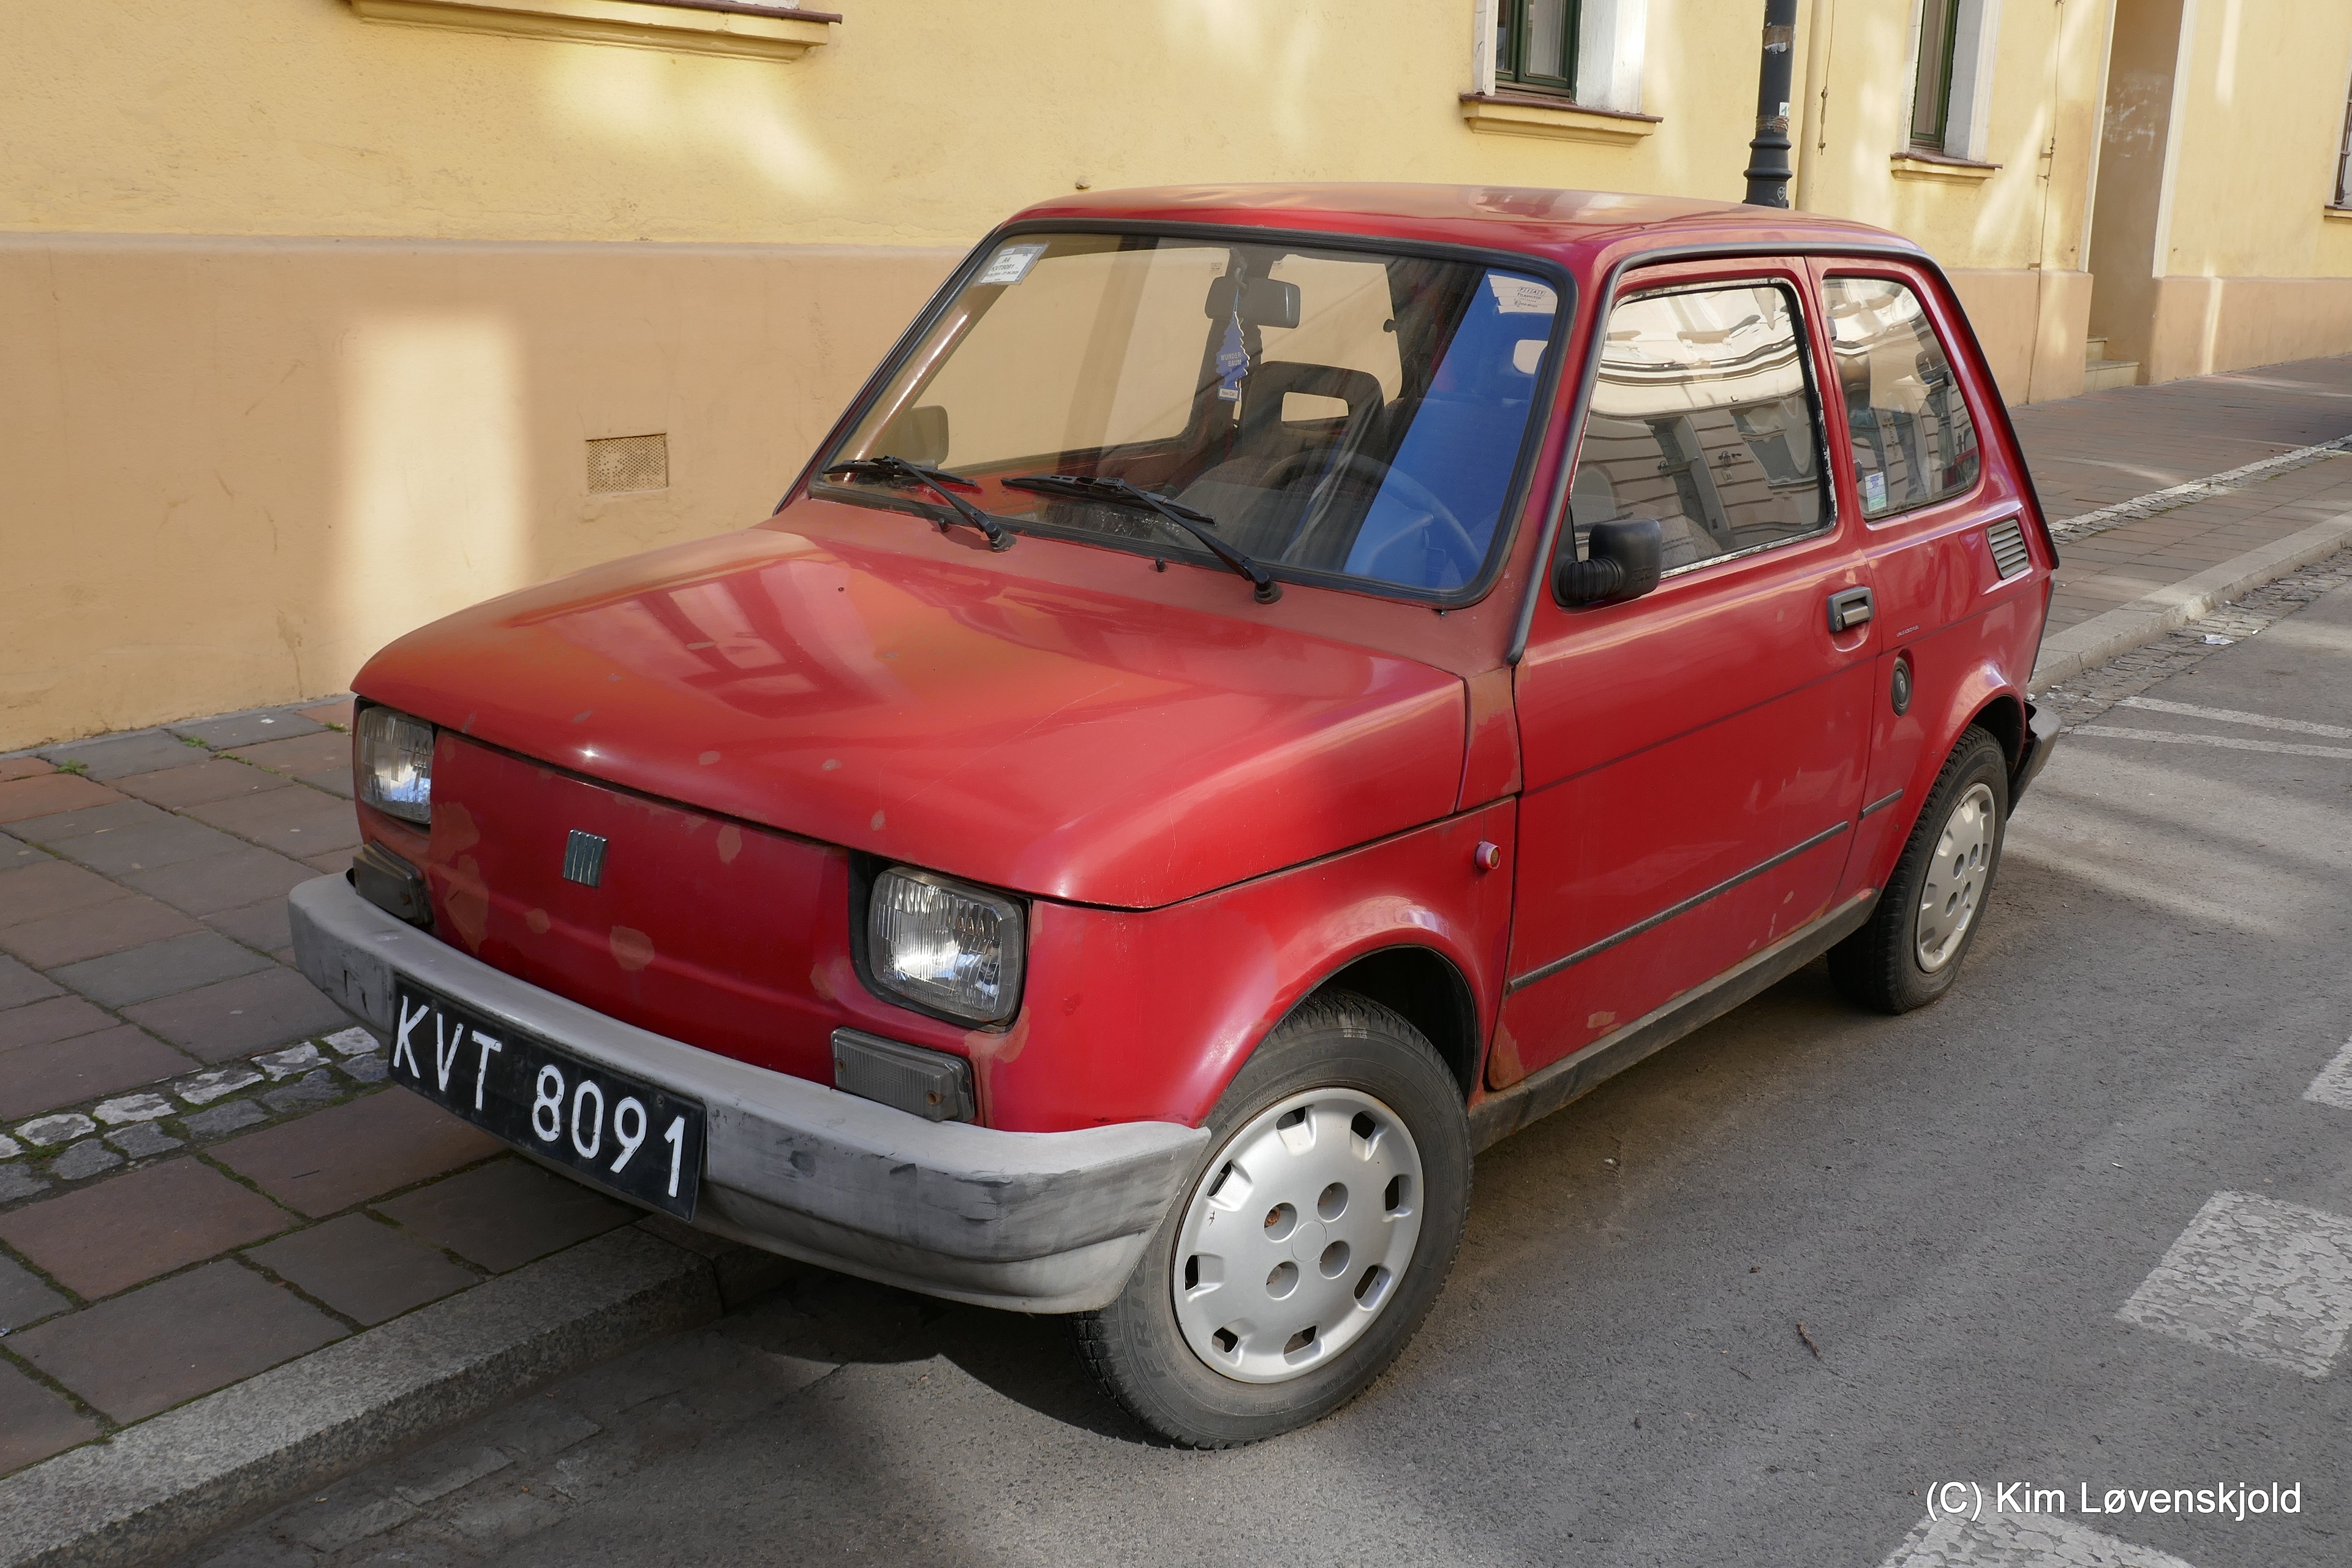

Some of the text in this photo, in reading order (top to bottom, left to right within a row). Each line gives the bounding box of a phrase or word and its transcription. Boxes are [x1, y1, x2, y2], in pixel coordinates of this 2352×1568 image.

[1518, 287, 1545, 296] FIAT
[1221, 352, 1243, 361] WUNDER-
[393, 995, 685, 1198] KVT 8091
